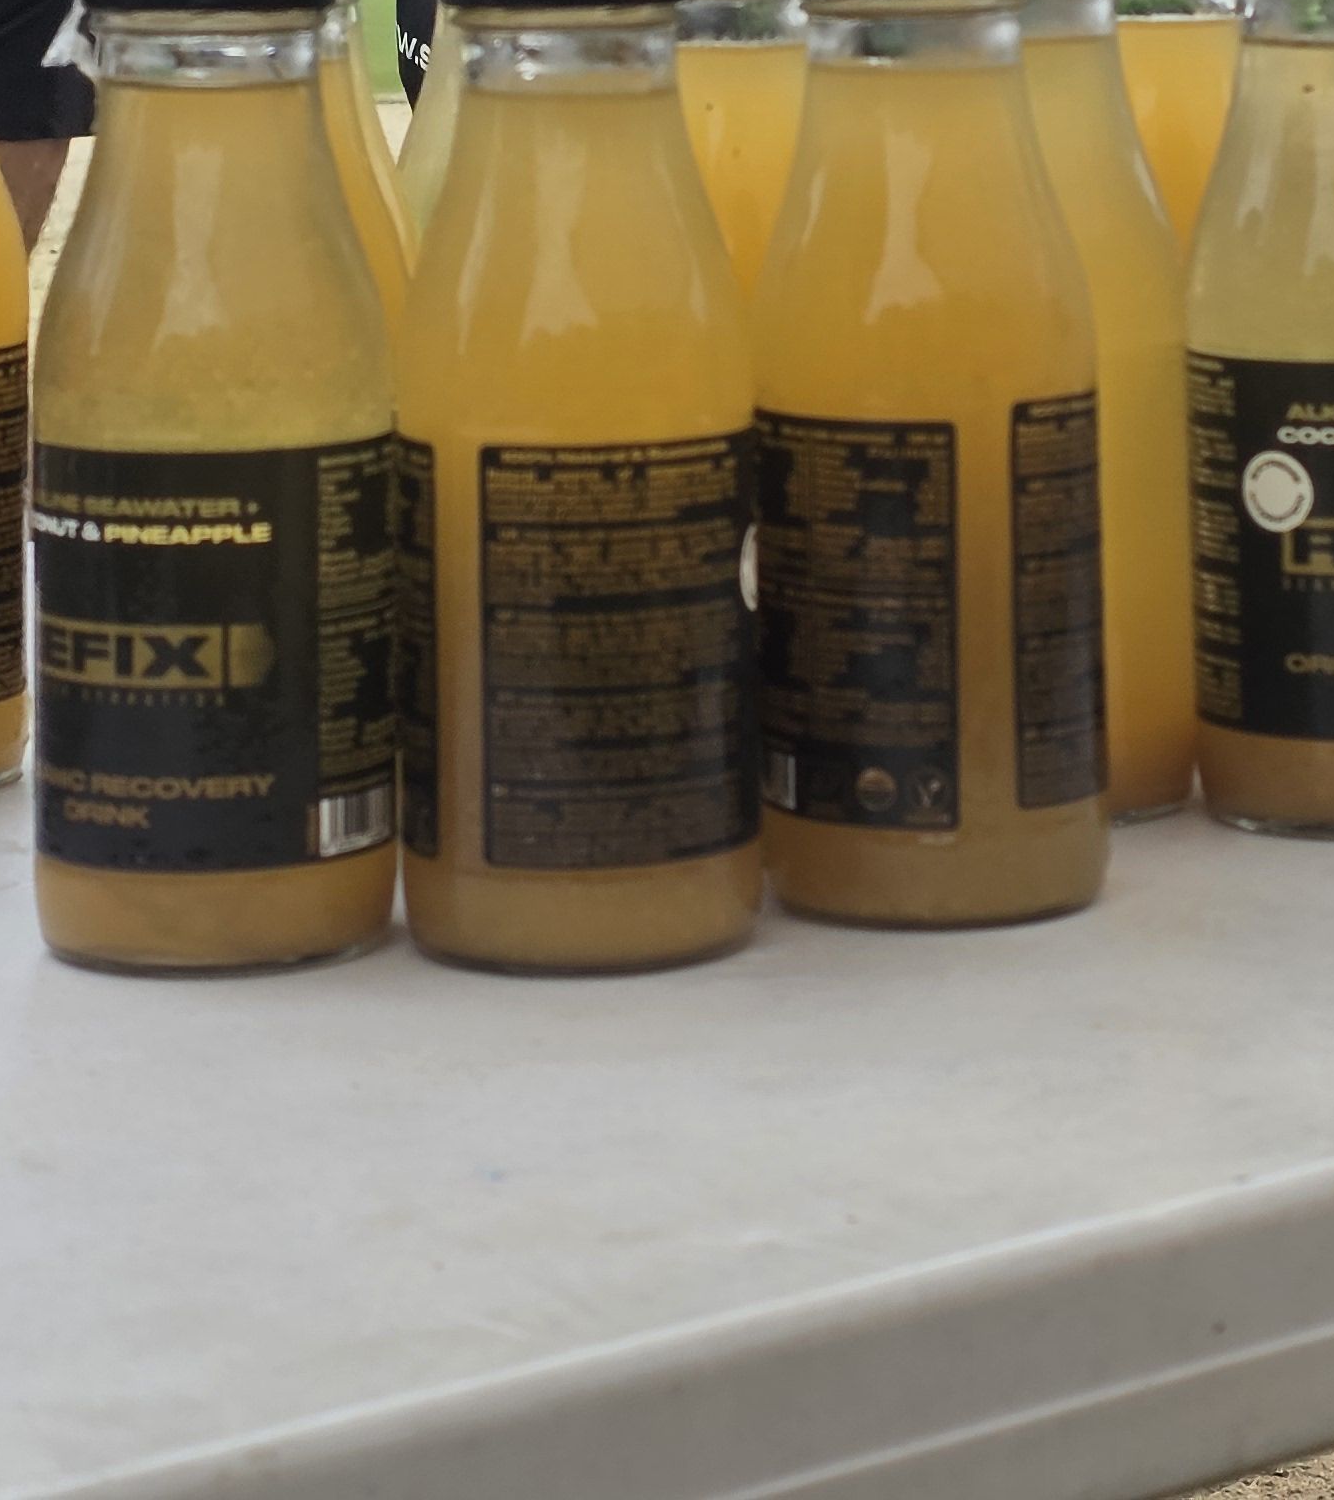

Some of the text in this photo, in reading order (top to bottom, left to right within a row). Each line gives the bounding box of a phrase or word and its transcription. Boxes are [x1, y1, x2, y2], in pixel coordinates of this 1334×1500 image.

[103, 521, 272, 545] PINEAPPLE
[41, 622, 212, 679] EFIX
[90, 772, 277, 800] RECOVERY
